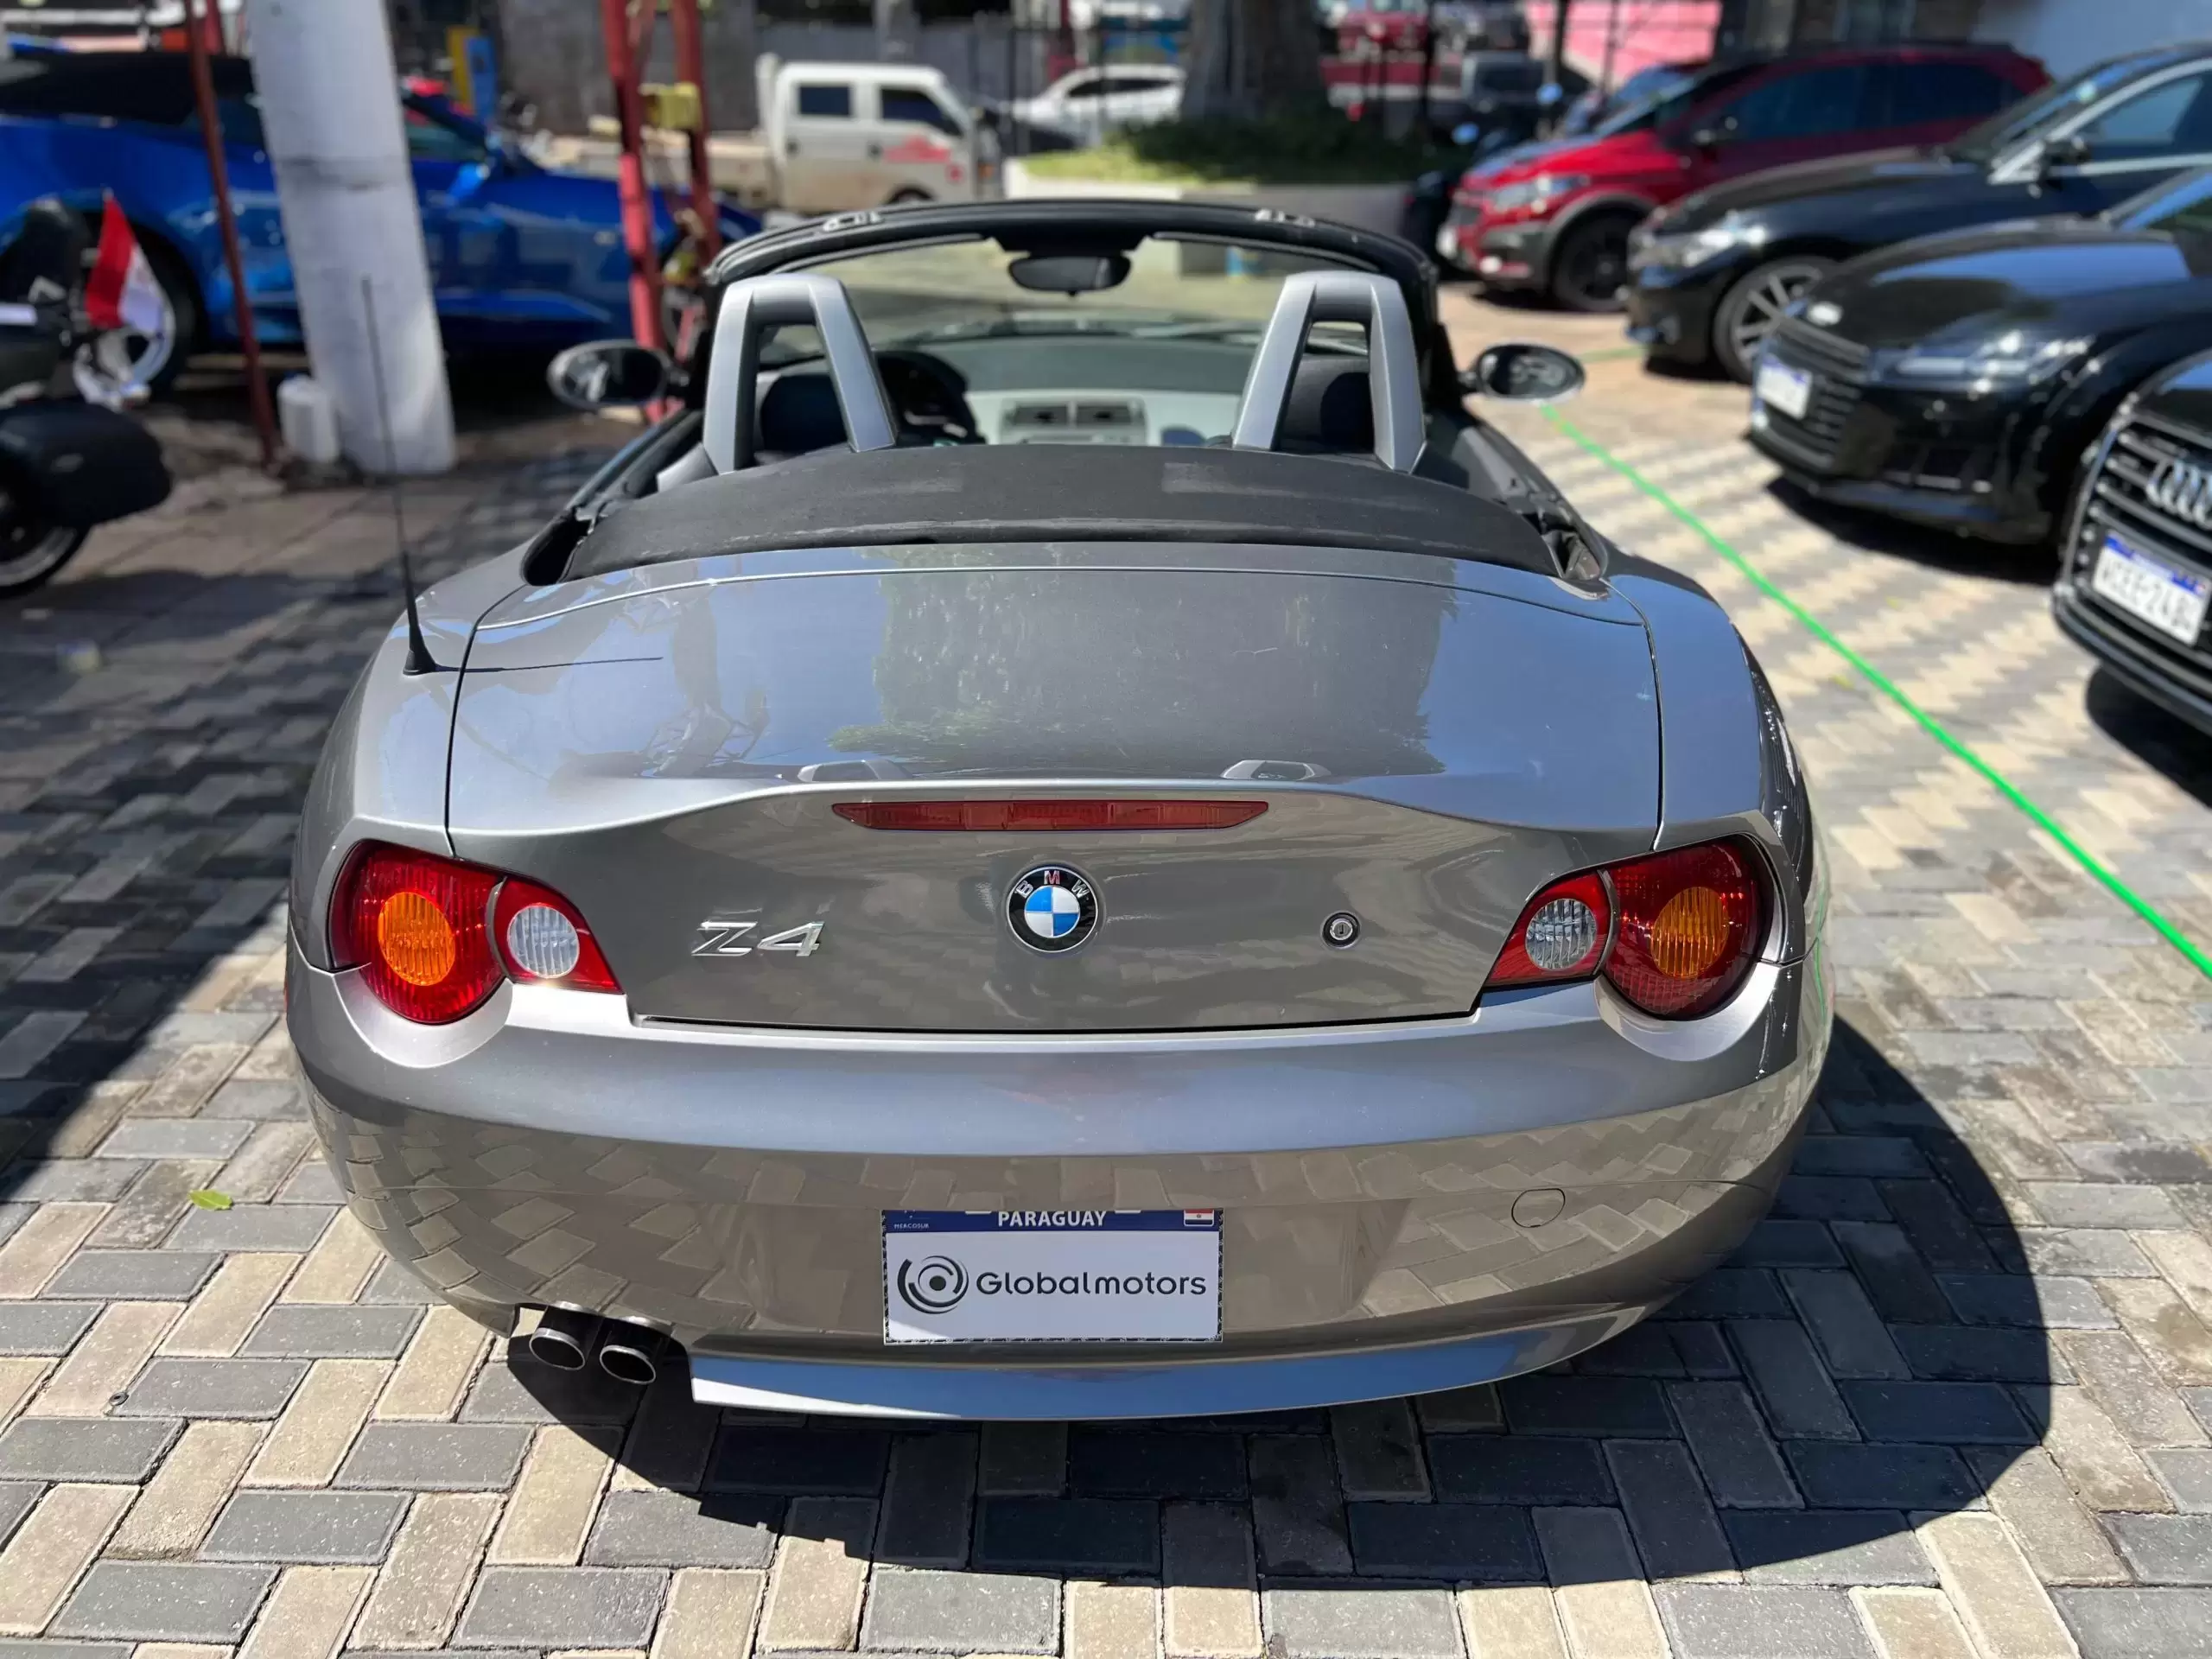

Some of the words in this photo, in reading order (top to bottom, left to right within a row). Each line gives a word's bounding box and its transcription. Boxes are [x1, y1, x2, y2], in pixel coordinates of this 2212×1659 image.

[1014, 870, 1090, 899] BMW
[690, 920, 826, 957] Z4
[997, 1210, 1108, 1227] PARAGUAY
[976, 1271, 1207, 1295] Globalmotors
